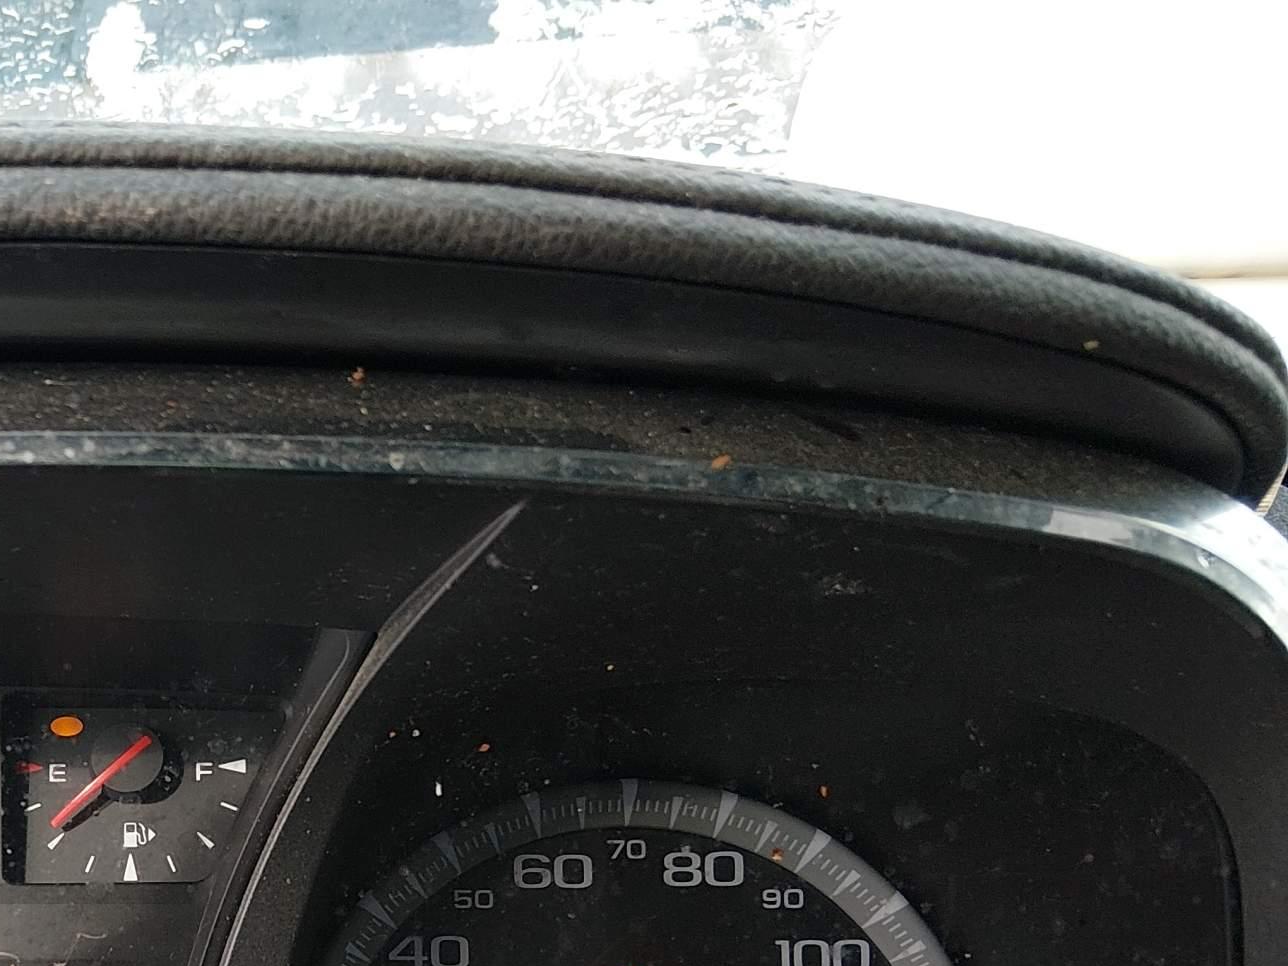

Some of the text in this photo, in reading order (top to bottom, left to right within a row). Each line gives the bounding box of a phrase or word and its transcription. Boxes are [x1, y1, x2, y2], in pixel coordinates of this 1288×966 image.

[49, 763, 67, 783] E
[195, 762, 213, 782] F
[606, 840, 647, 859] 70
[513, 855, 593, 889] 60
[662, 851, 744, 887] 80
[454, 890, 494, 909] 50
[762, 889, 804, 909] 90
